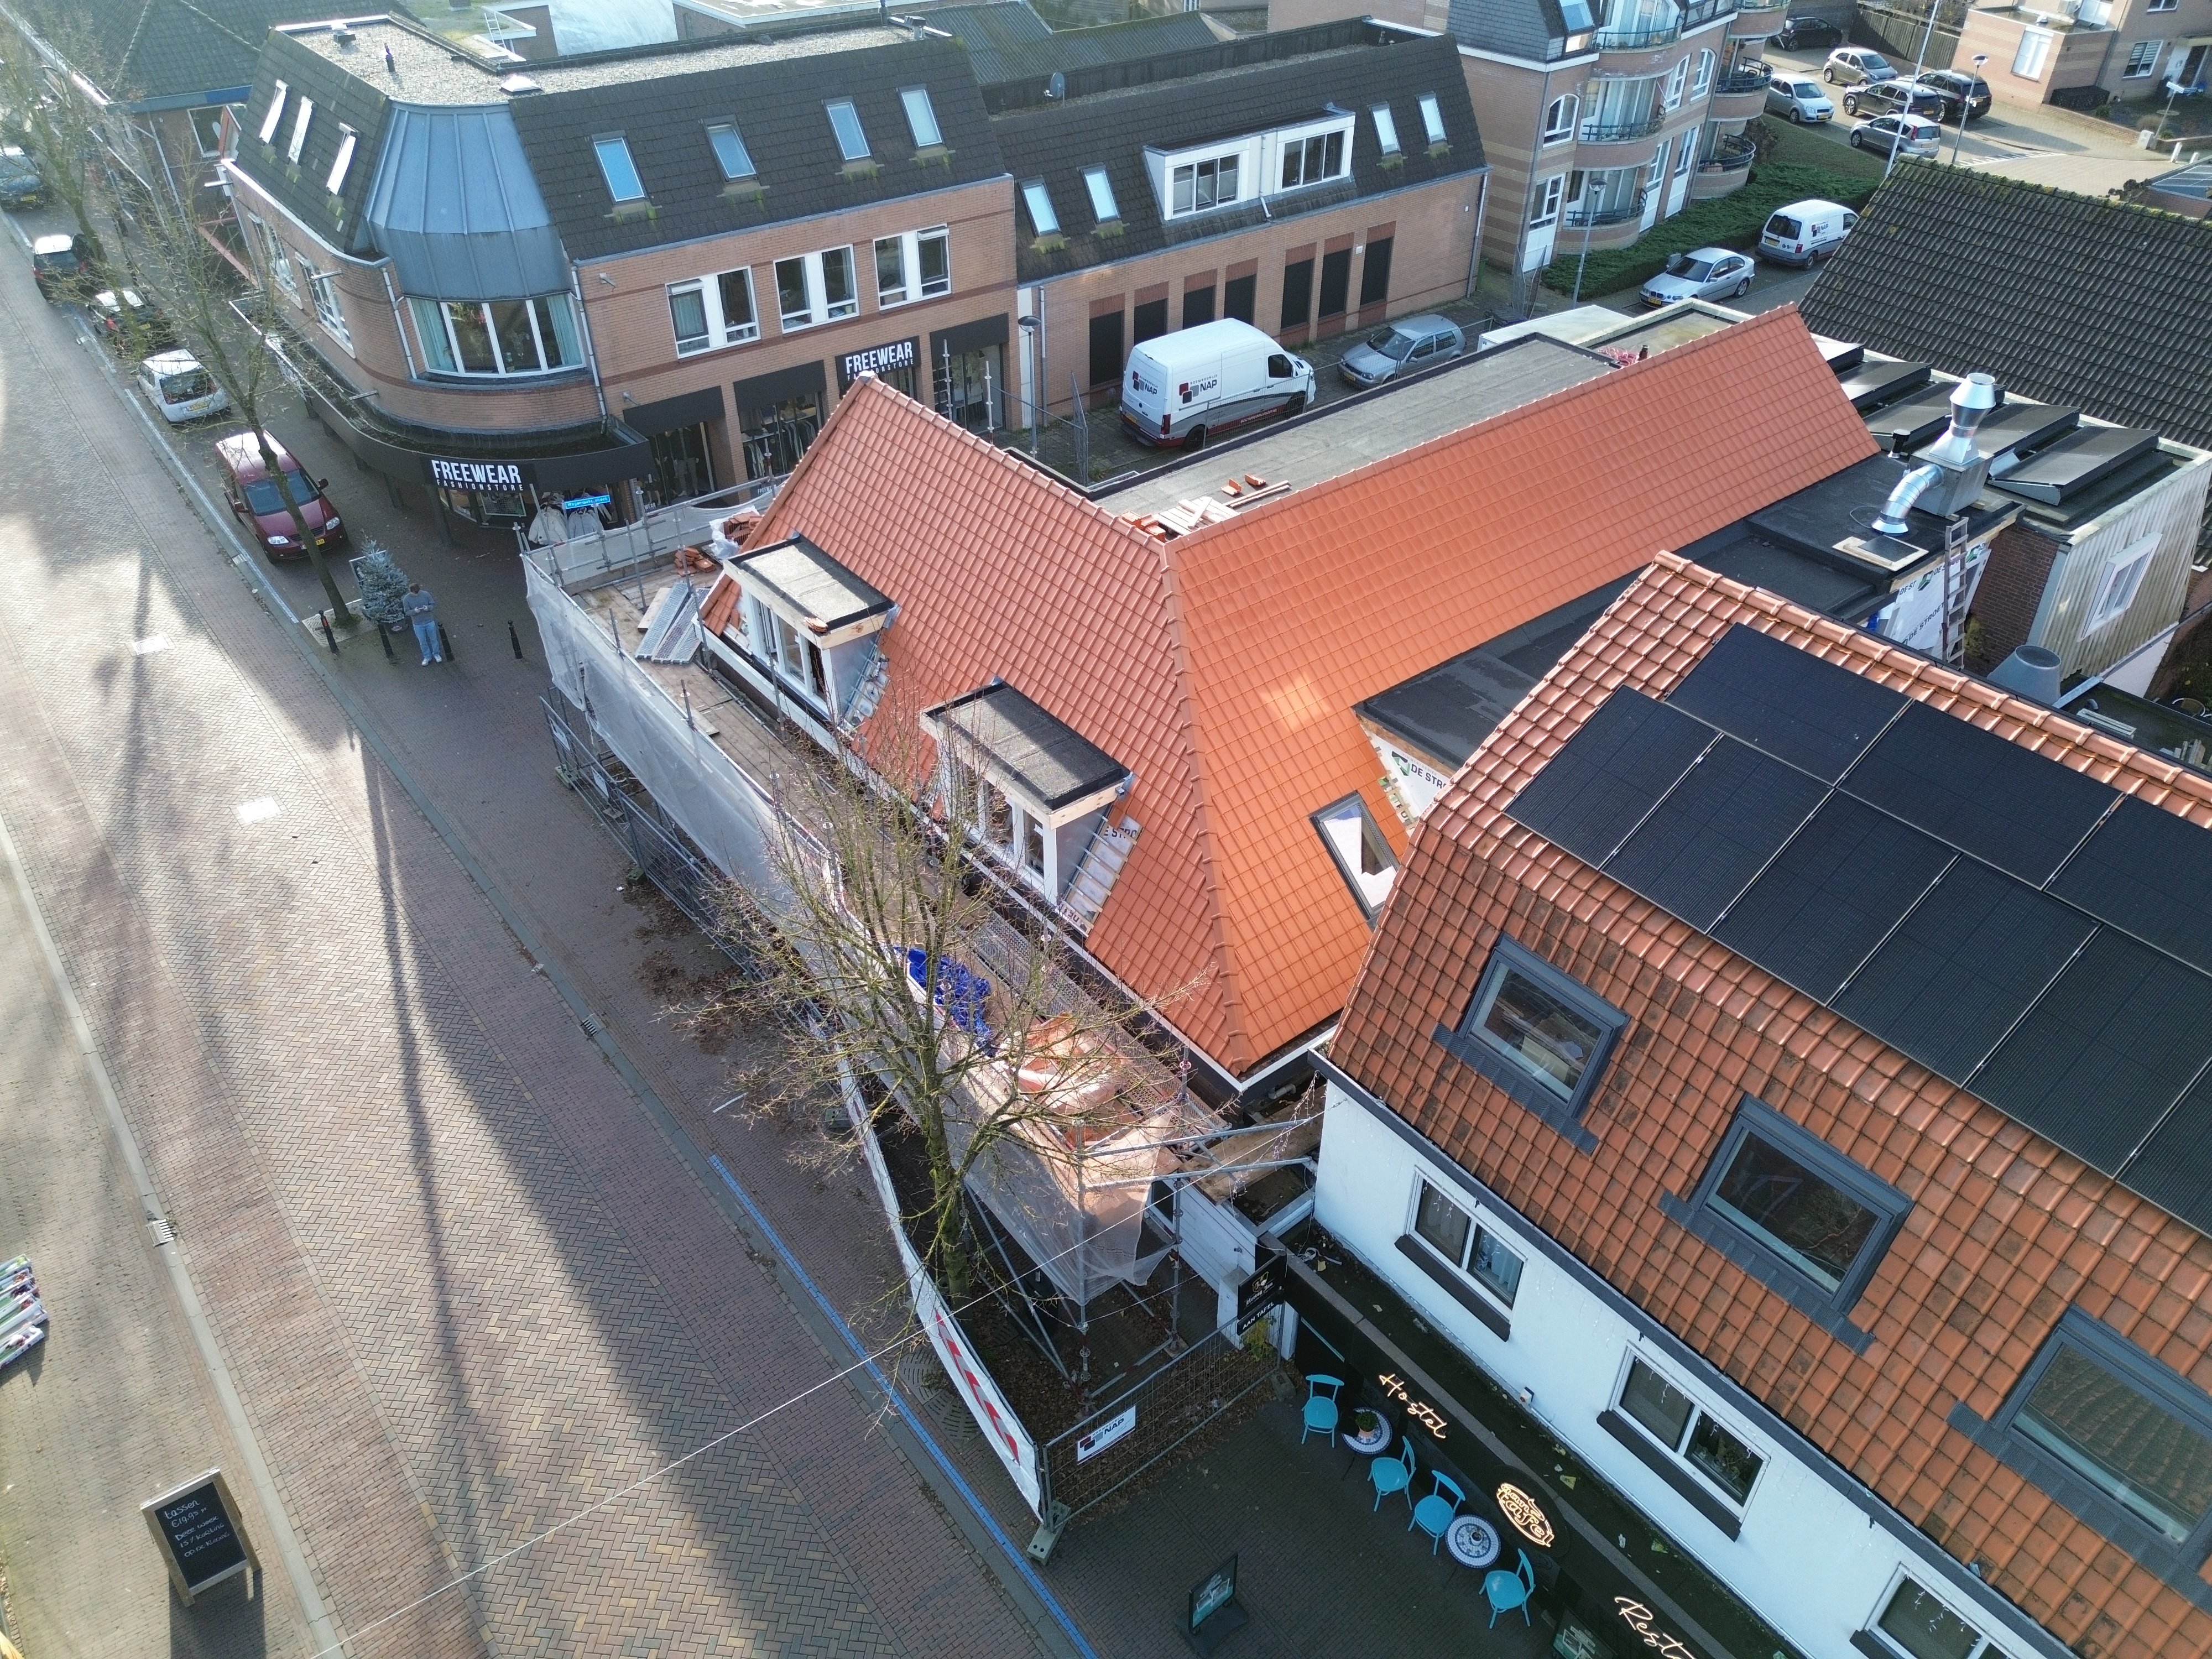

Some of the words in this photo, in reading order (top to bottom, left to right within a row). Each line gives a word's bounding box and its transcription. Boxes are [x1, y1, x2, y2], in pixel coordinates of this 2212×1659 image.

[846, 342, 912, 374] FREEWEAR
[847, 359, 913, 381] FAONSTORE
[1145, 383, 1157, 395] NAP
[1200, 379, 1217, 392] NAP
[431, 460, 521, 483] FREEWEAR
[437, 479, 523, 491] FASHIONSTORE
[1908, 629, 1918, 641] DE
[1411, 764, 1423, 777] DE
[1243, 1316, 1255, 1329] AAN
[1256, 1302, 1275, 1318] TAFEL
[1379, 1373, 1447, 1439] Hostel
[1104, 1418, 1124, 1434] NAP
[1614, 1596, 1696, 1659] Rest
